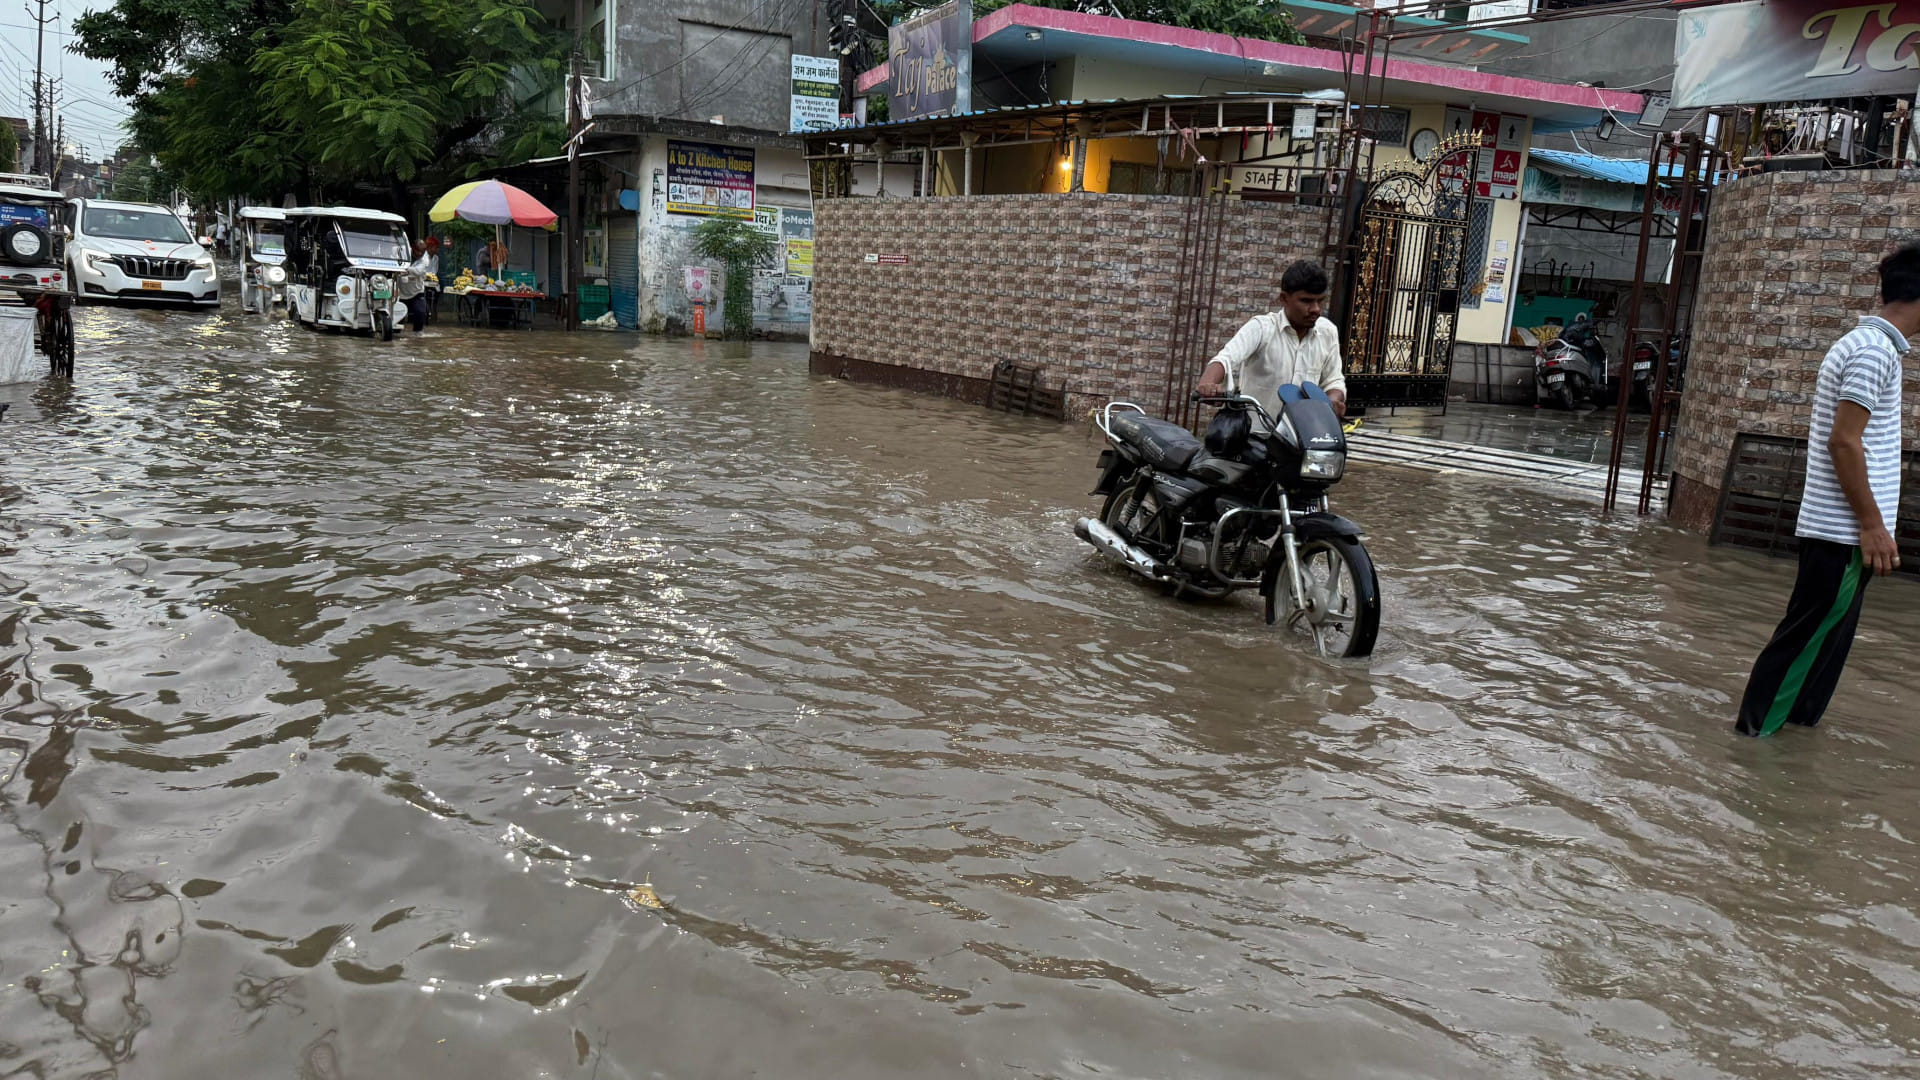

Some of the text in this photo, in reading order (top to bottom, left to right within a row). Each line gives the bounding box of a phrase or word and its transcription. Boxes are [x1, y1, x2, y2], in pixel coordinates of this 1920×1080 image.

[892, 37, 924, 112] Taj
[669, 150, 753, 172] A to Z Kitchen House
[1493, 170, 1518, 183] mapl
